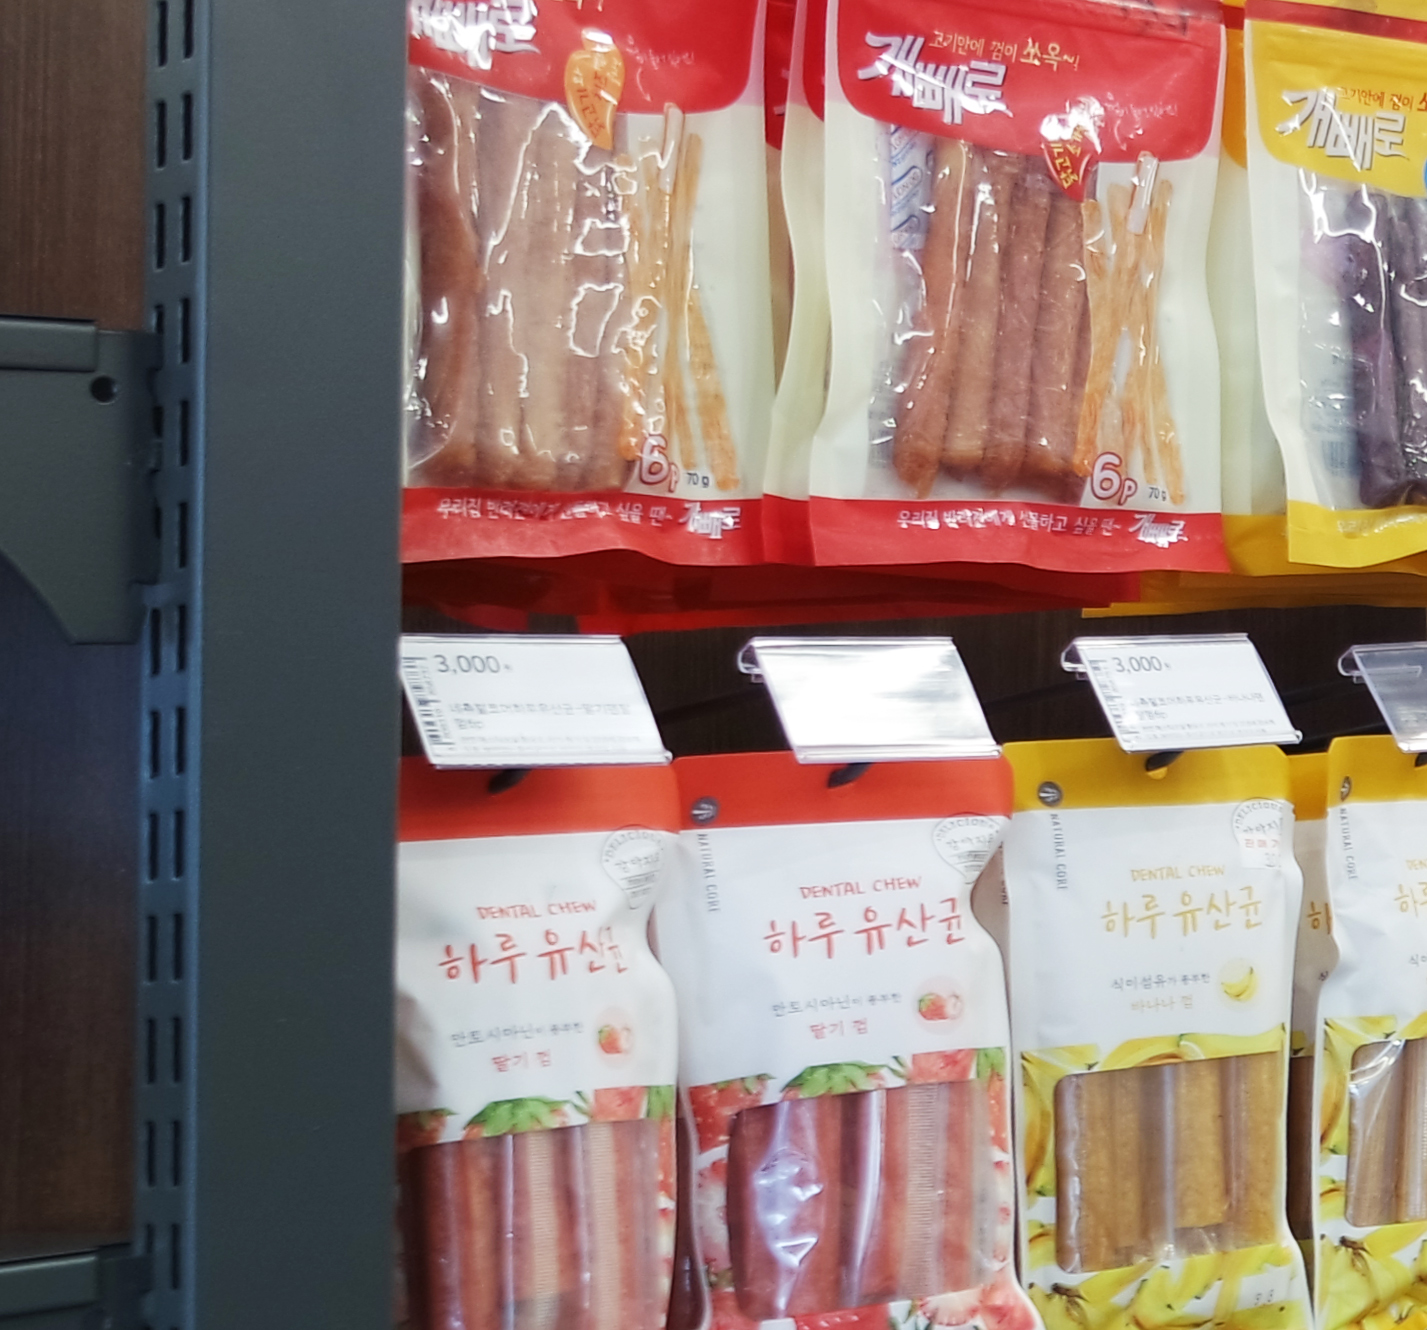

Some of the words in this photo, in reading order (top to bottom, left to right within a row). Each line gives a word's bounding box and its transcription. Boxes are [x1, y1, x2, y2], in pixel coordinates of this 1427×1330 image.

[929, 30, 984, 57] 고기안에
[1275, 87, 1410, 172] 개빼로
[1131, 867, 1181, 881] DENTAL
[1189, 865, 1225, 877] CHEW
[800, 881, 865, 899] DENTAL
[873, 876, 922, 892] CHEW
[477, 904, 541, 919] DENTAL
[548, 900, 596, 915] CHEW
